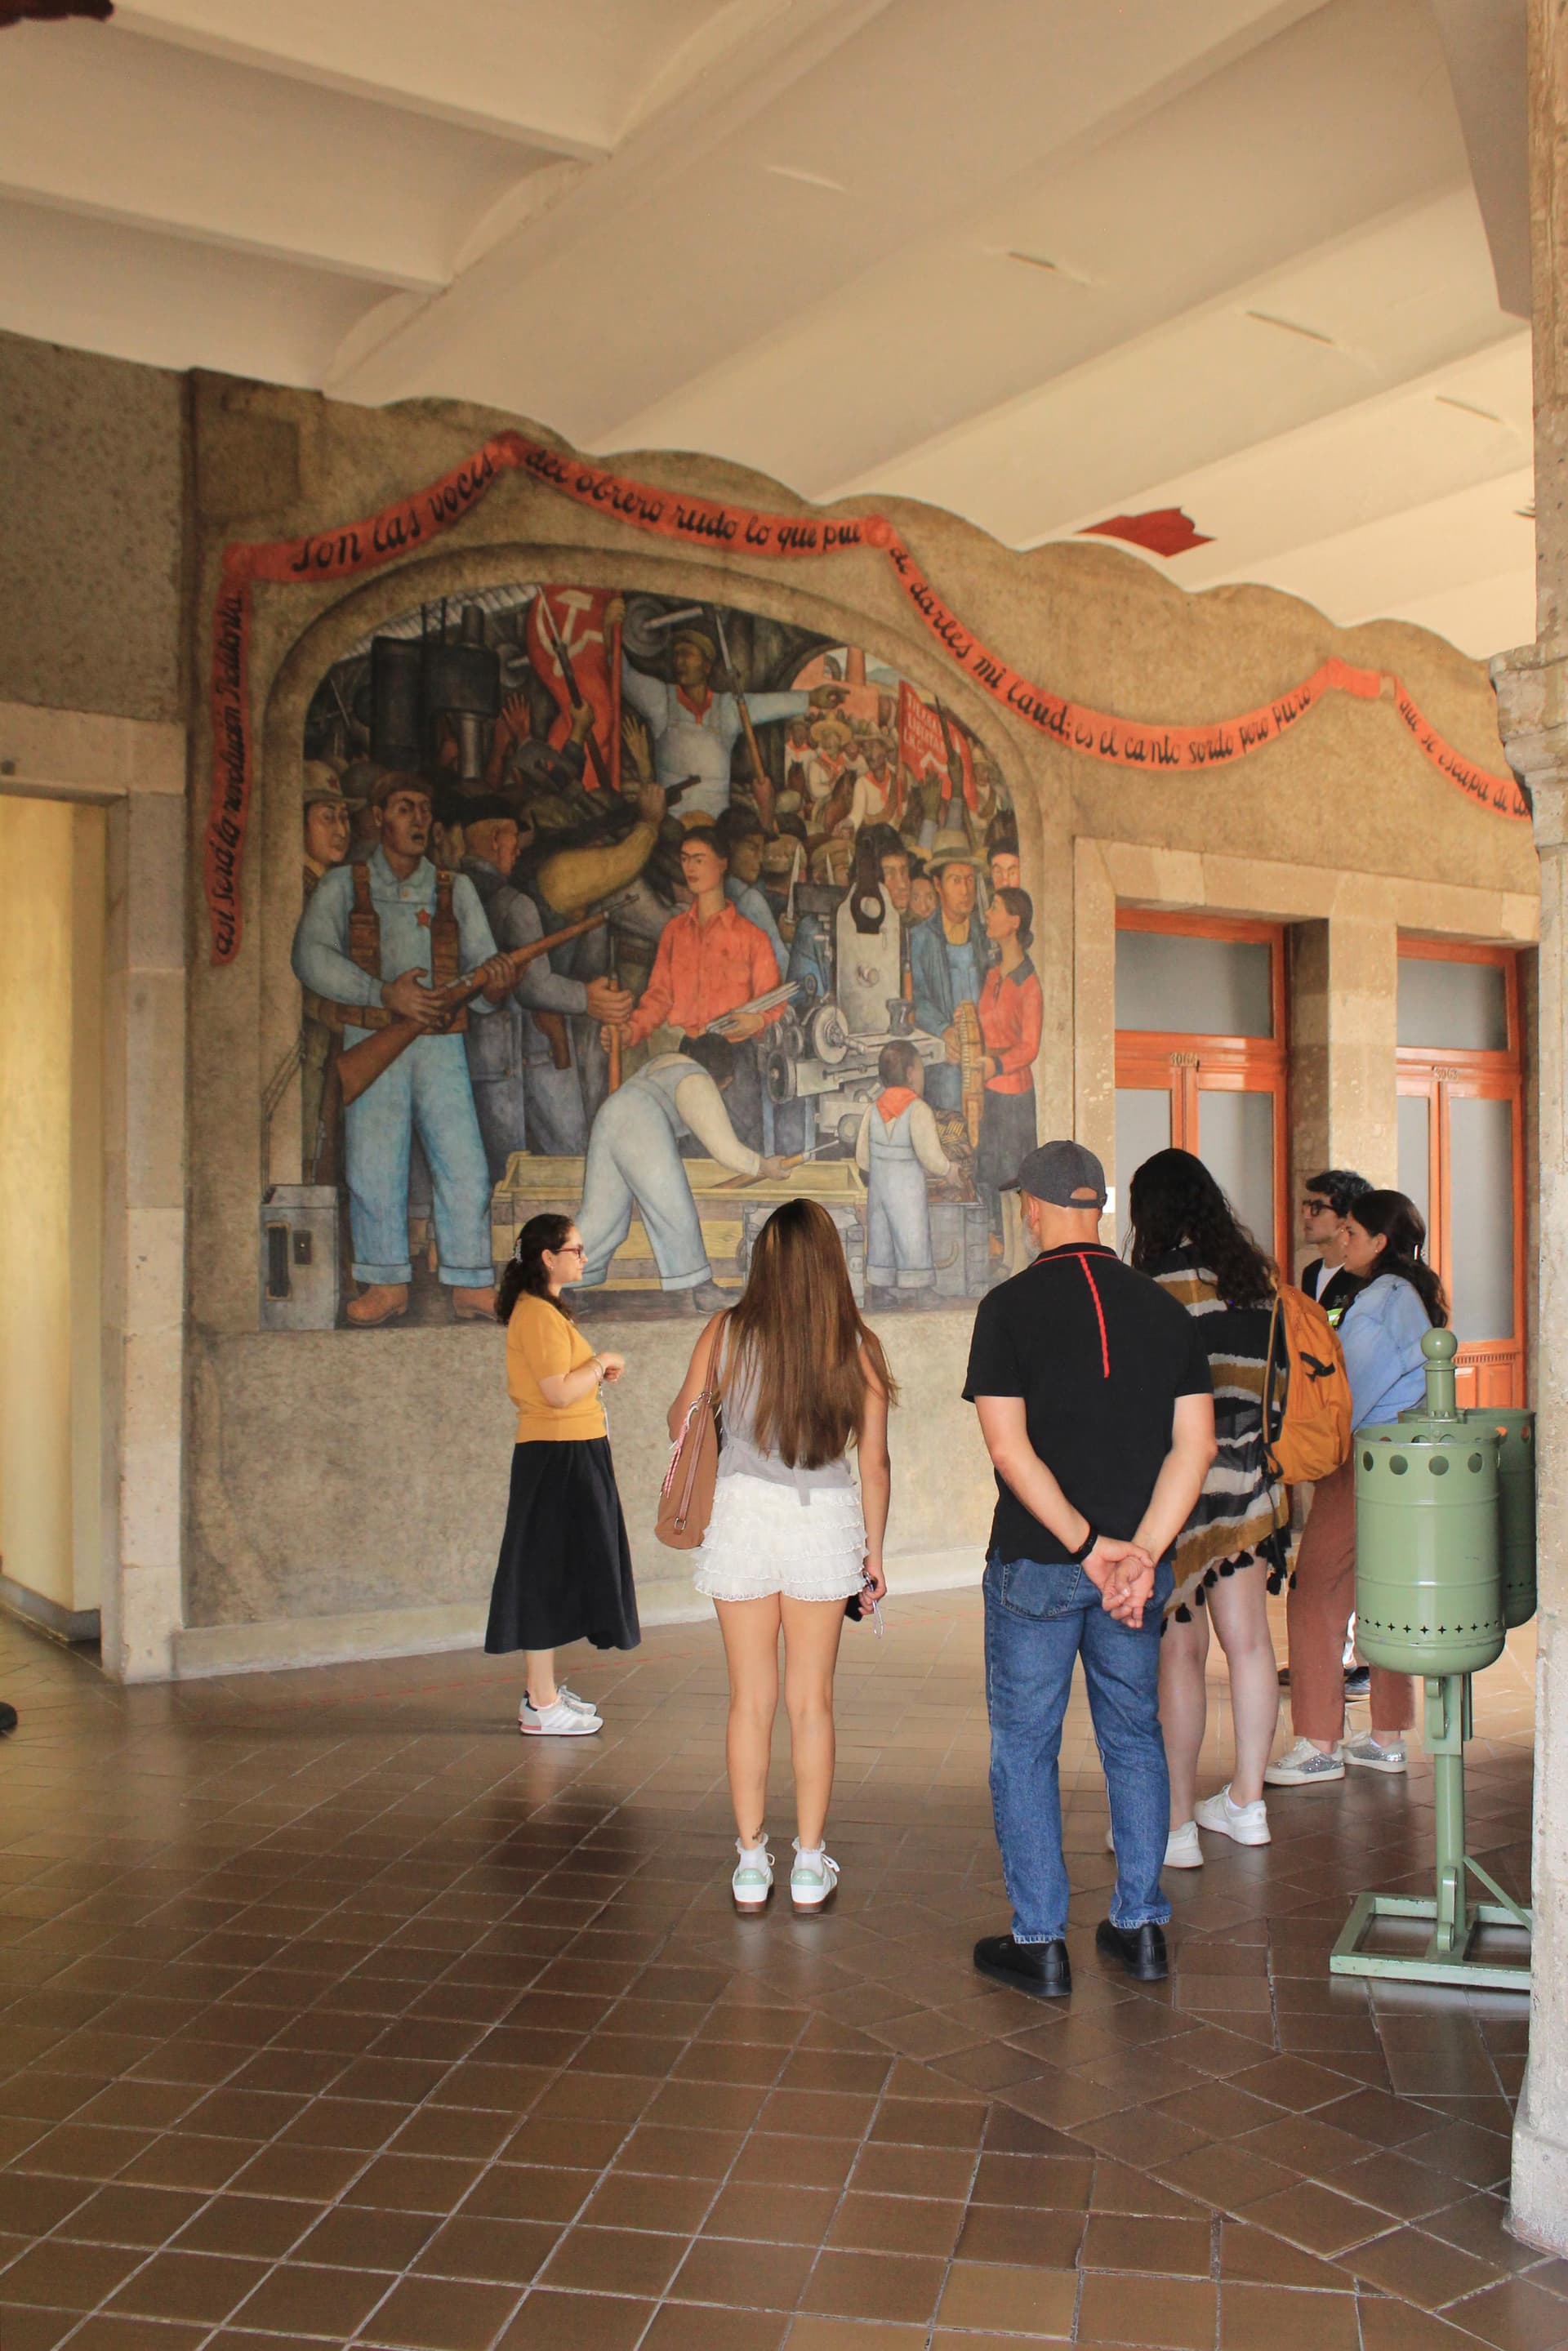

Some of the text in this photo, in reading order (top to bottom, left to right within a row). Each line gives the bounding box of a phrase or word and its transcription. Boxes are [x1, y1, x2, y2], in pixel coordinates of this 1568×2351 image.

[373, 510, 421, 553] las
[575, 474, 664, 523] obrero
[673, 504, 737, 541] rudo
[745, 514, 772, 545] lo
[777, 525, 817, 551] que
[910, 581, 973, 659] darles
[973, 656, 1007, 688] mi
[1075, 724, 1094, 748] es
[1099, 727, 1118, 757] el
[1124, 735, 1181, 764] canto
[1188, 728, 1234, 764] sordo
[1239, 716, 1269, 754] pero
[1272, 685, 1312, 731] puro
[212, 816, 241, 848] la
